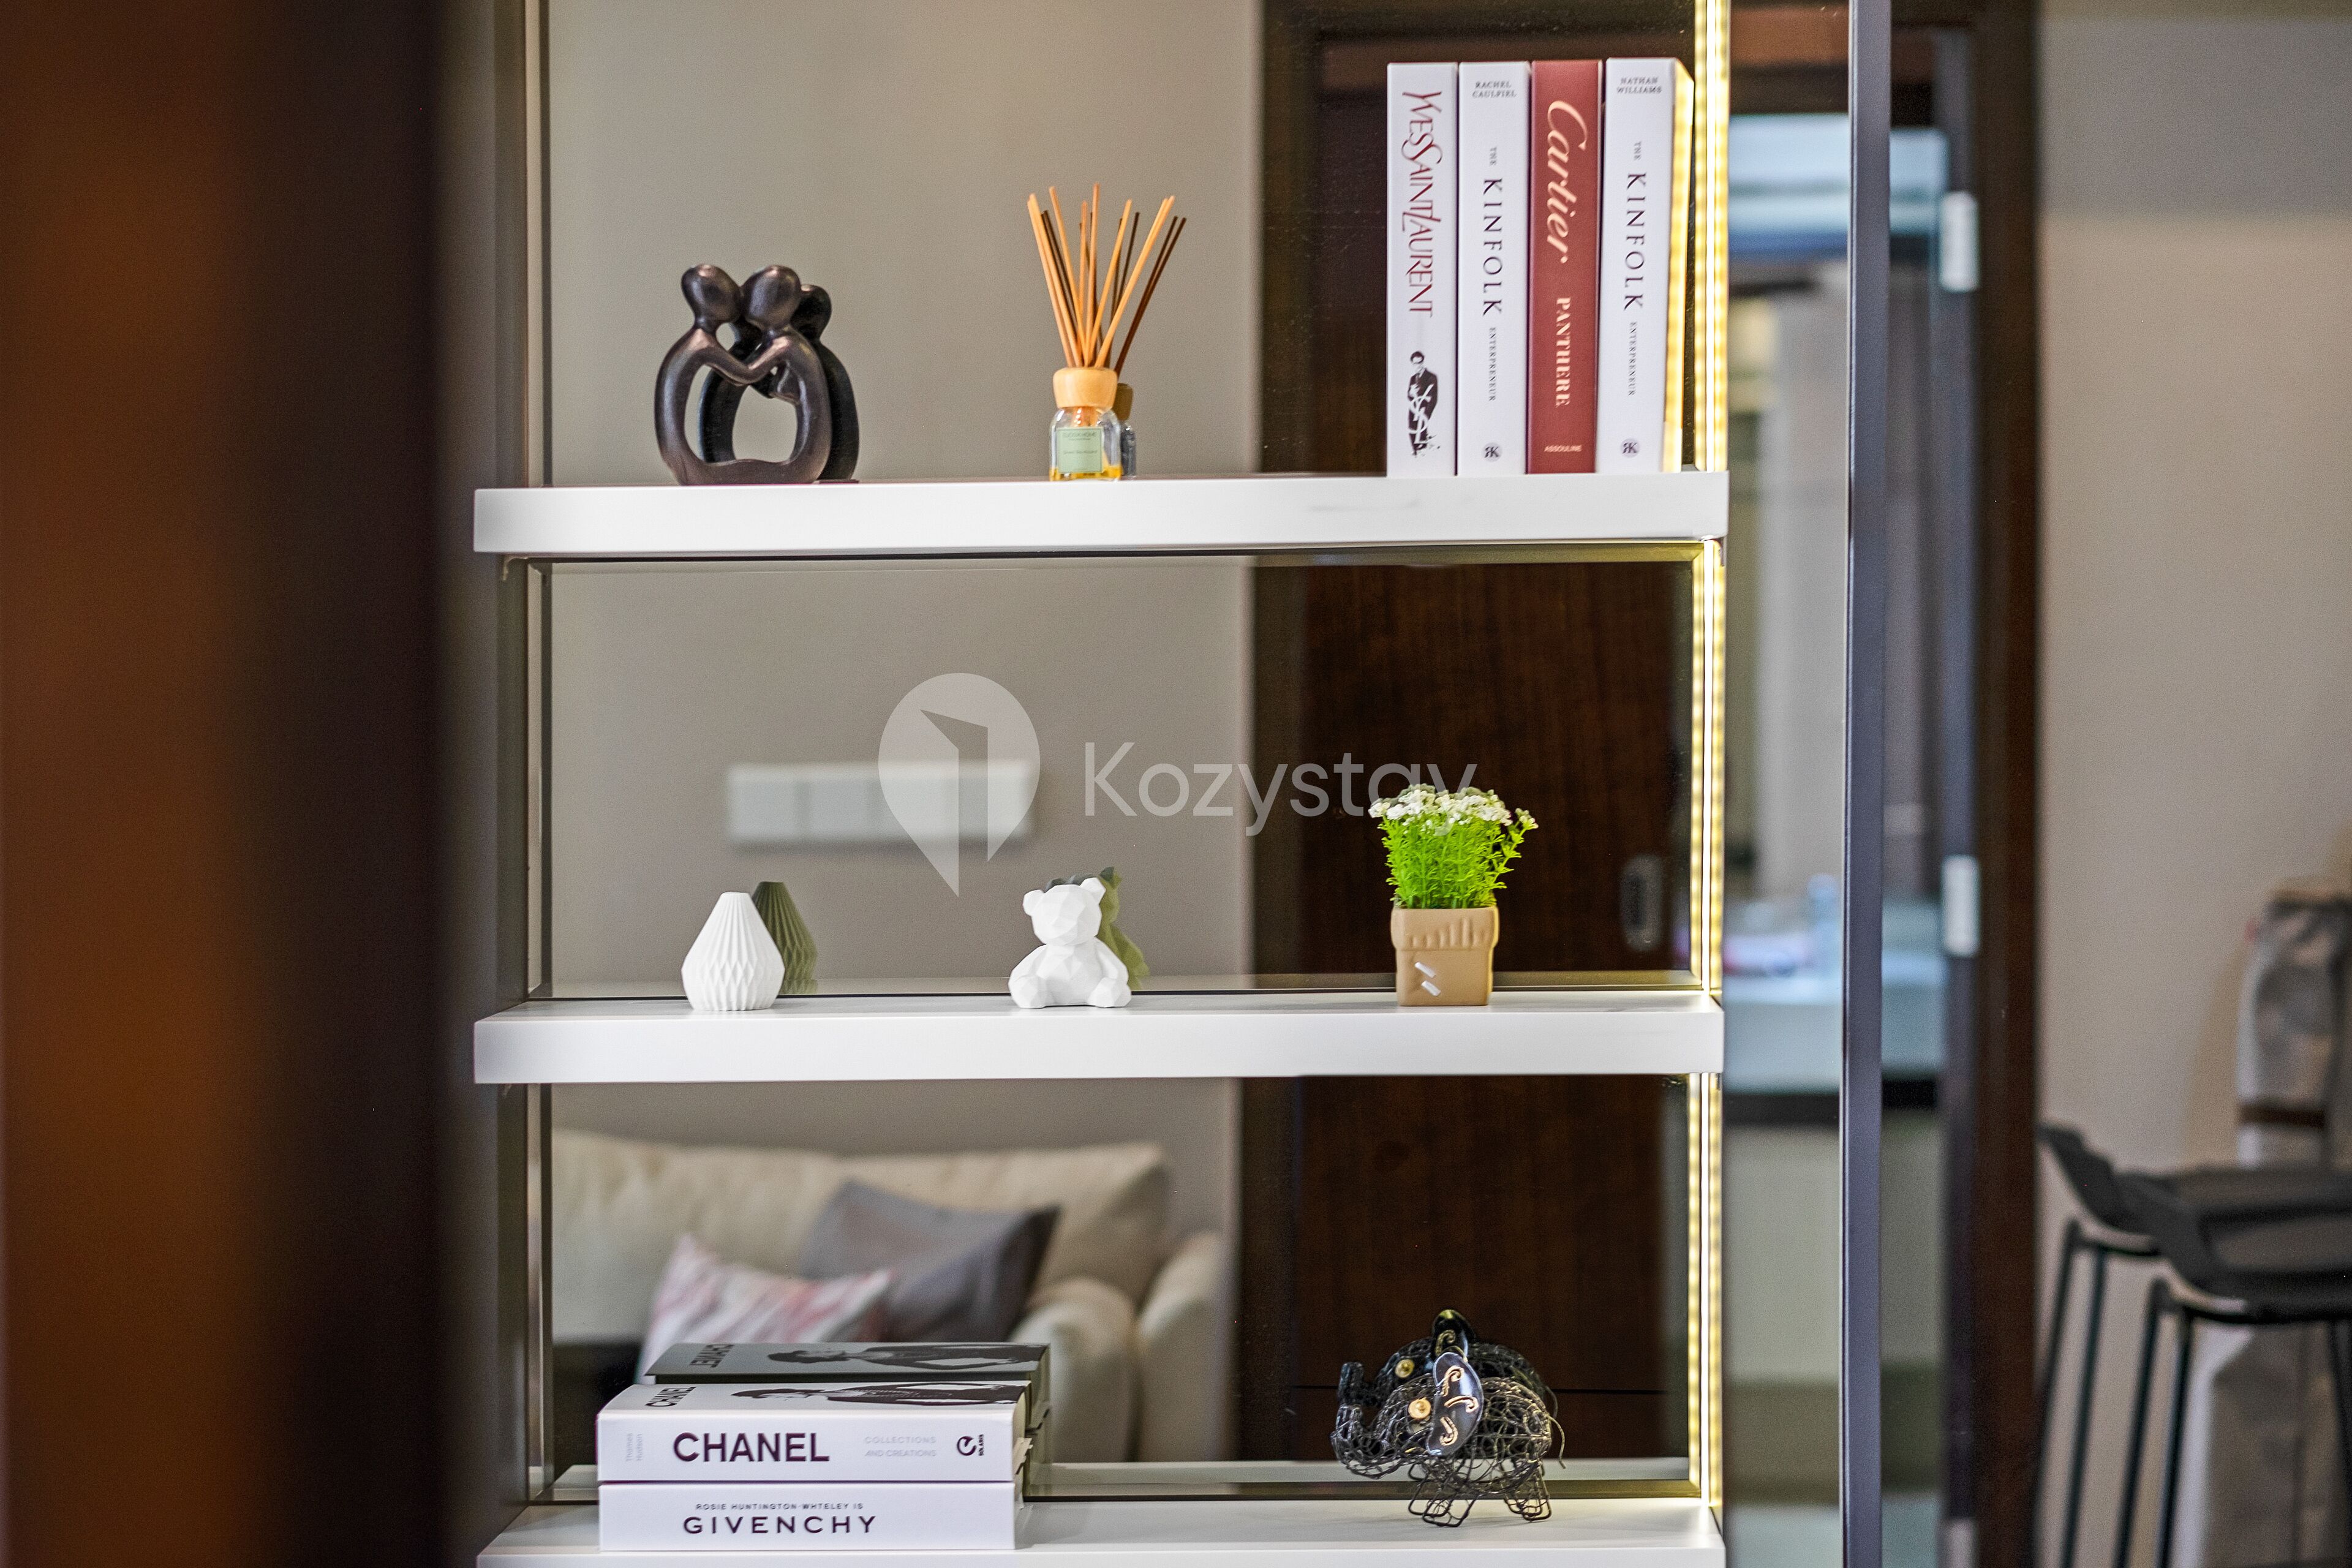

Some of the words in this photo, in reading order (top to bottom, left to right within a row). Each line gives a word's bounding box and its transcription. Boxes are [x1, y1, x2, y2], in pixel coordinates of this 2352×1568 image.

[1547, 100, 1588, 264] Cartier
[1624, 172, 1646, 311] KINFOLK
[1483, 178, 1502, 316] KINFOLK
[1555, 297, 1572, 408] PANTHERE
[673, 1432, 830, 1462] CHANEL
[683, 1515, 876, 1534] GIVENCHY
